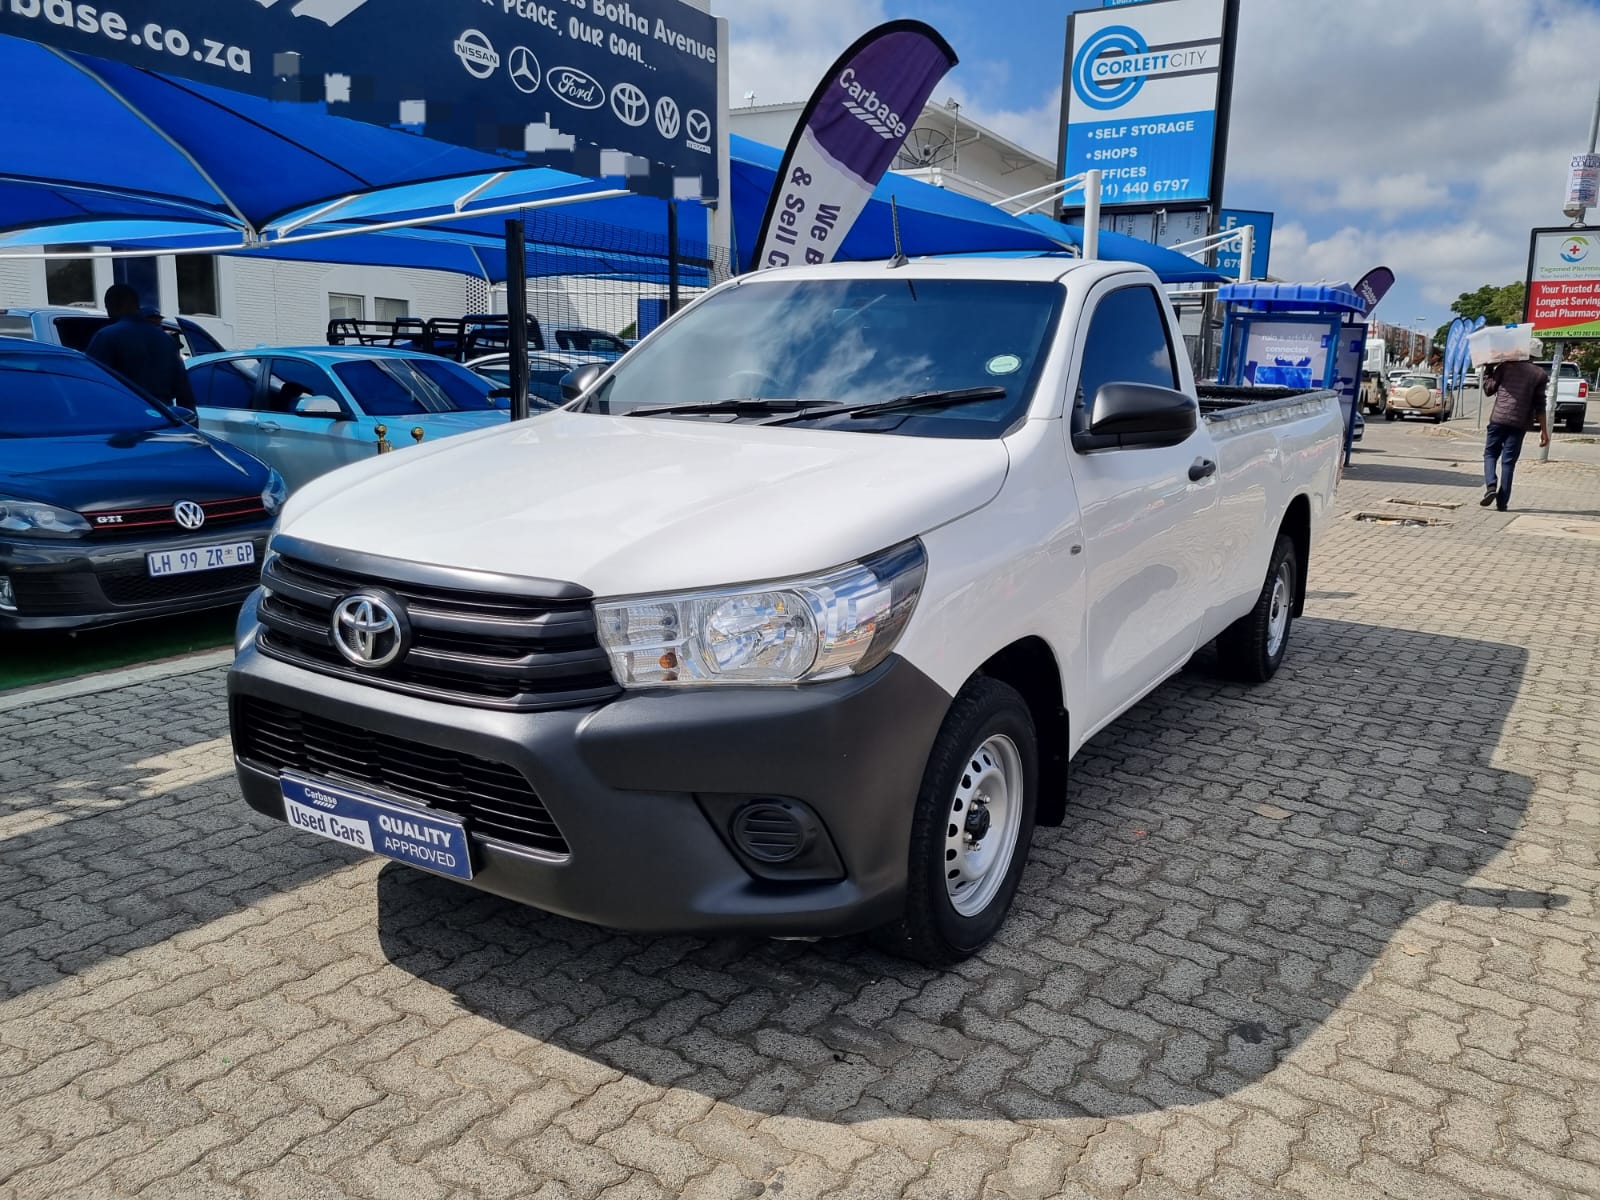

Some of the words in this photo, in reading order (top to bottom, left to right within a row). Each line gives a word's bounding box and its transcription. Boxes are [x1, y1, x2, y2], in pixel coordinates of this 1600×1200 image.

[0, 0, 252, 74] base.co.za
[569, 17, 603, 47] OUR
[593, 0, 649, 35] Botha
[653, 19, 717, 63] Avenue
[456, 44, 498, 66] NISSAN
[557, 72, 594, 103] Ford
[839, 68, 907, 138] Carbase
[1095, 126, 1127, 140] SELF
[1130, 120, 1195, 136] STORAGE
[1093, 147, 1138, 161] SHOPS
[791, 166, 812, 187] &
[1100, 166, 1147, 180] FFICES
[1122, 181, 1149, 194] 440
[1153, 178, 1190, 191] 6797
[775, 193, 805, 245] Sell
[810, 203, 841, 242] We
[1536, 296, 1569, 307] Longest
[1541, 285, 1560, 294] Your
[1561, 284, 1593, 294] Trusted
[1535, 308, 1558, 318] Local
[1559, 308, 1600, 320] Pharmacy
[96, 515, 123, 523] GTI
[151, 553, 171, 574] LH
[180, 551, 198, 569] 99
[207, 549, 224, 566] ZR
[237, 545, 252, 562] GP
[304, 787, 338, 805] Carbase
[290, 805, 327, 833] Used
[330, 817, 366, 846] Cars
[378, 814, 452, 848] QUALITY
[384, 837, 456, 868] APPROVED
